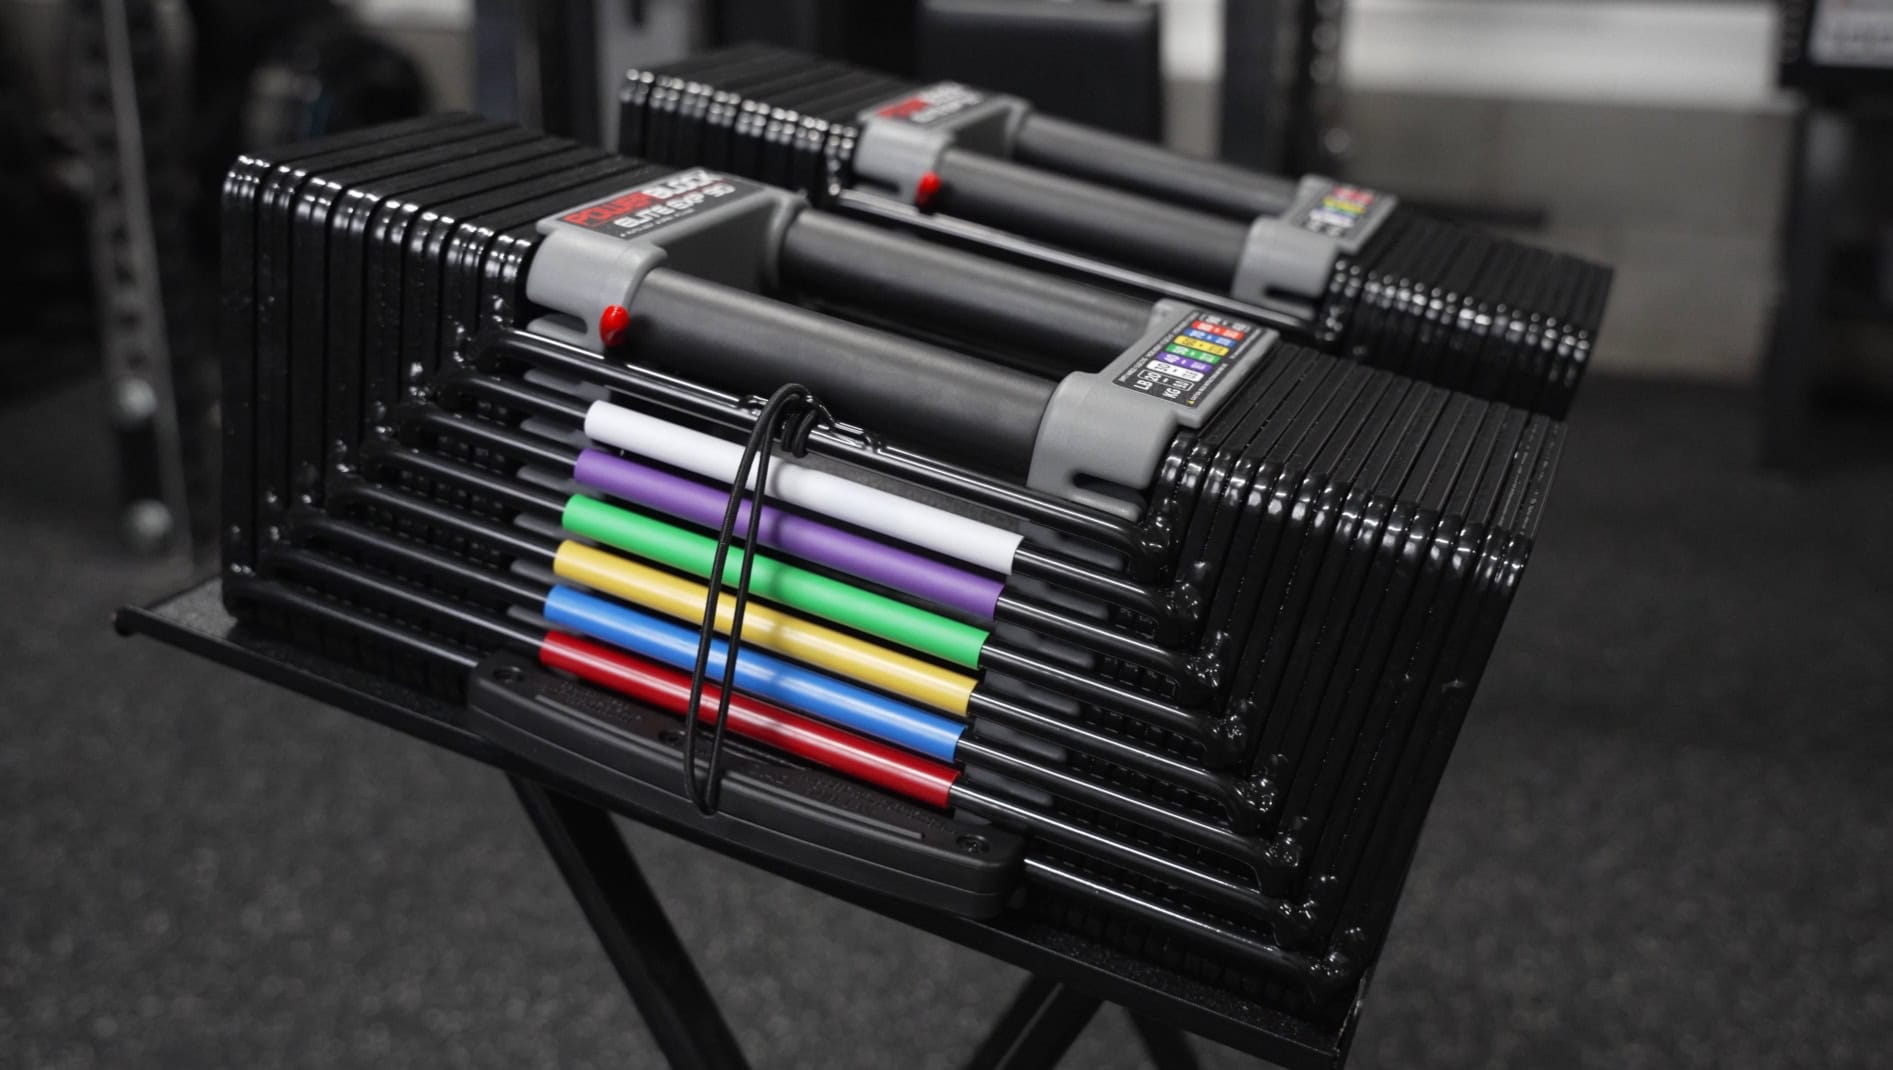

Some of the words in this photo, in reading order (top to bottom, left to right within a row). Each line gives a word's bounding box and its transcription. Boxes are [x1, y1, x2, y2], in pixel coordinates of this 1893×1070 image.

[613, 204, 676, 229] ELITE
[1144, 371, 1161, 382] 20
[1133, 379, 1153, 390] LB
[1162, 387, 1181, 399] KG
